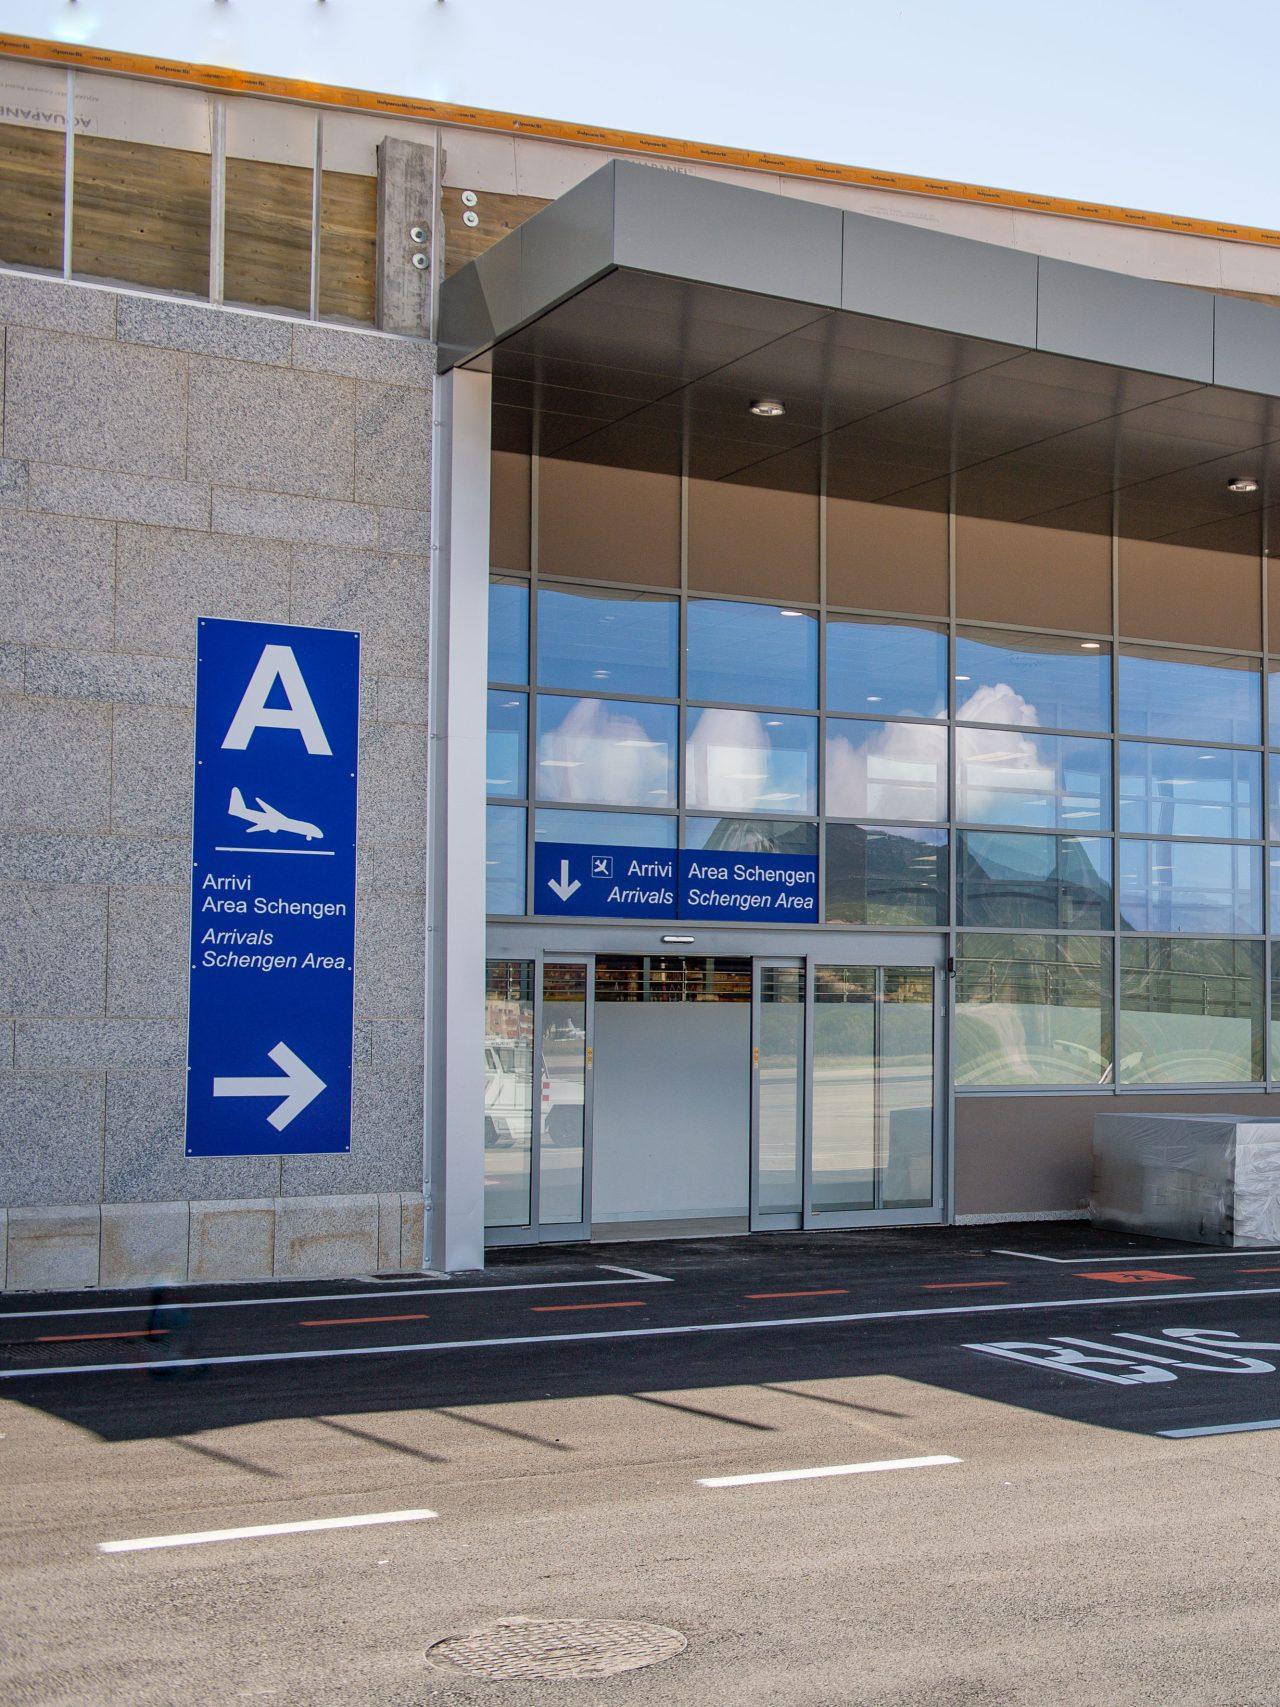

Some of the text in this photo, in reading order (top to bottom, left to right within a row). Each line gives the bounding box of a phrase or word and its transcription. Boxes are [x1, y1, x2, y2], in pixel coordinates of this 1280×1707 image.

[221, 644, 332, 755] A
[202, 873, 251, 891] Arrivi
[628, 861, 815, 883] Arrivi Area Schengen
[202, 897, 346, 919] Area Schengen
[608, 886, 813, 910] Arrivals Schengen Area
[201, 928, 273, 945] Arrivals
[202, 951, 345, 971] Schengen Area
